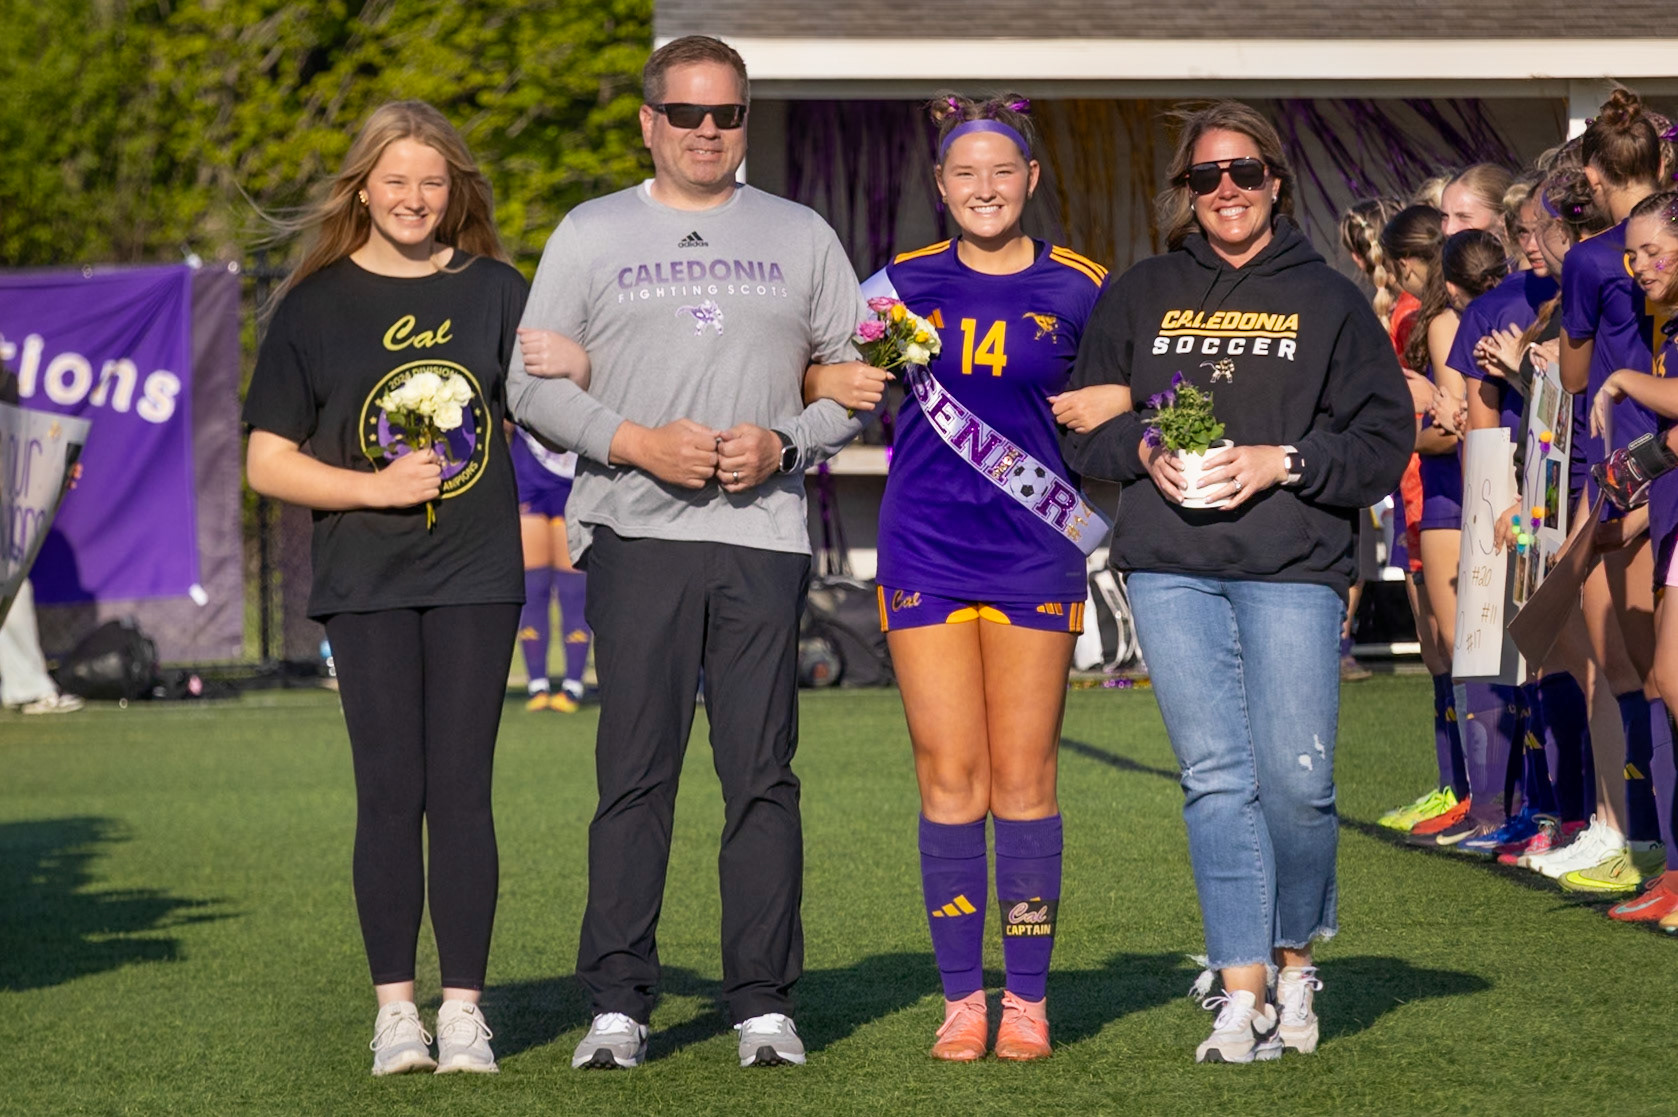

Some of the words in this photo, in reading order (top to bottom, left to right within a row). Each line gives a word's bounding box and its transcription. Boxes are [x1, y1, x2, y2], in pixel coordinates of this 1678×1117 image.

[678, 240, 709, 249] adidas
[618, 258, 786, 290] CALEDONIA
[618, 284, 718, 304] FIGHTING
[727, 284, 788, 298] SCOTS
[1161, 309, 1299, 331] CALEDONIA
[383, 314, 453, 351] Cal
[960, 317, 1008, 377] 14
[1152, 336, 1297, 362] SOCCER
[442, 460, 479, 492] AMPIONS
[1471, 565, 1493, 587] #20
[891, 589, 923, 613] Cal
[1008, 901, 1048, 925] Cal
[1006, 924, 1051, 936] CAPTAIN
